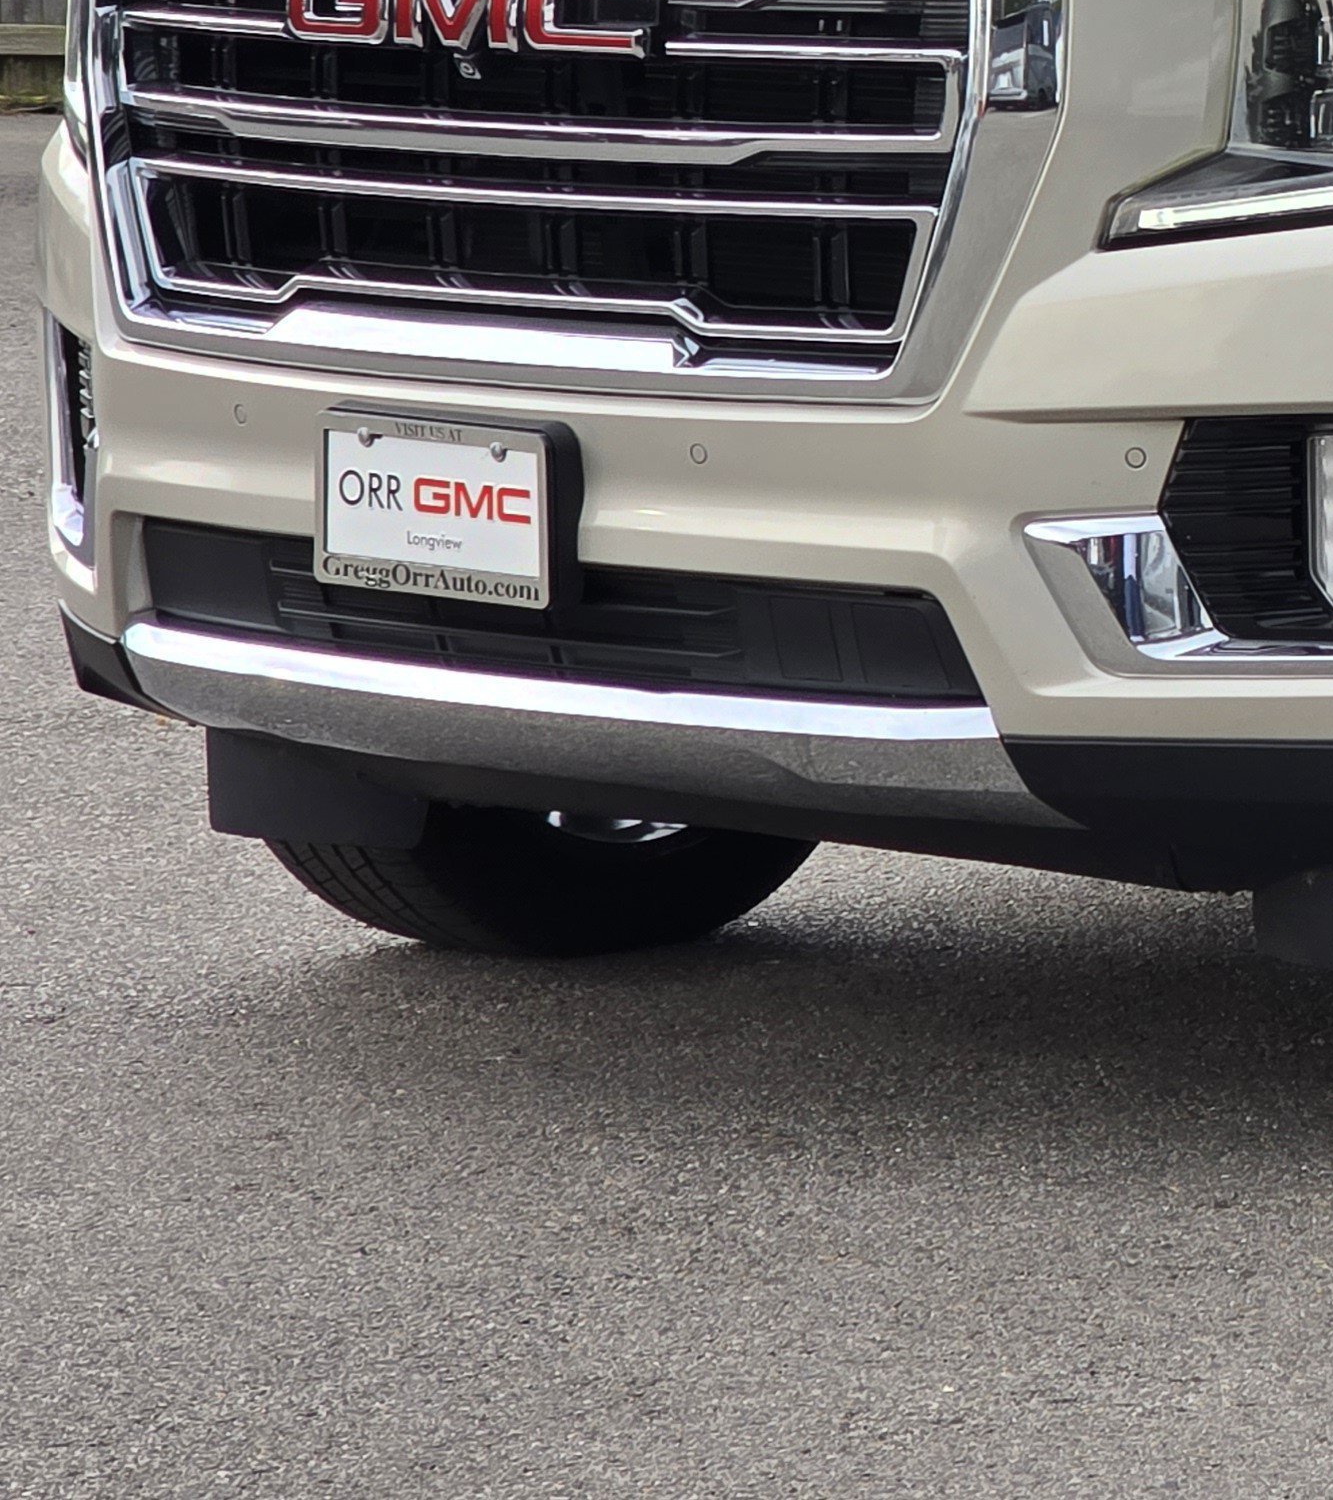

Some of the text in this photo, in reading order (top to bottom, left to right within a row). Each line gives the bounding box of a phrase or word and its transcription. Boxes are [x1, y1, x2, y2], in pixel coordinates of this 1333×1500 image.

[394, 422, 463, 442] VISIT US AT
[338, 469, 532, 525] ORR GMC
[406, 530, 463, 551] Longview
[322, 554, 540, 601] GreggOrrAuto.com
